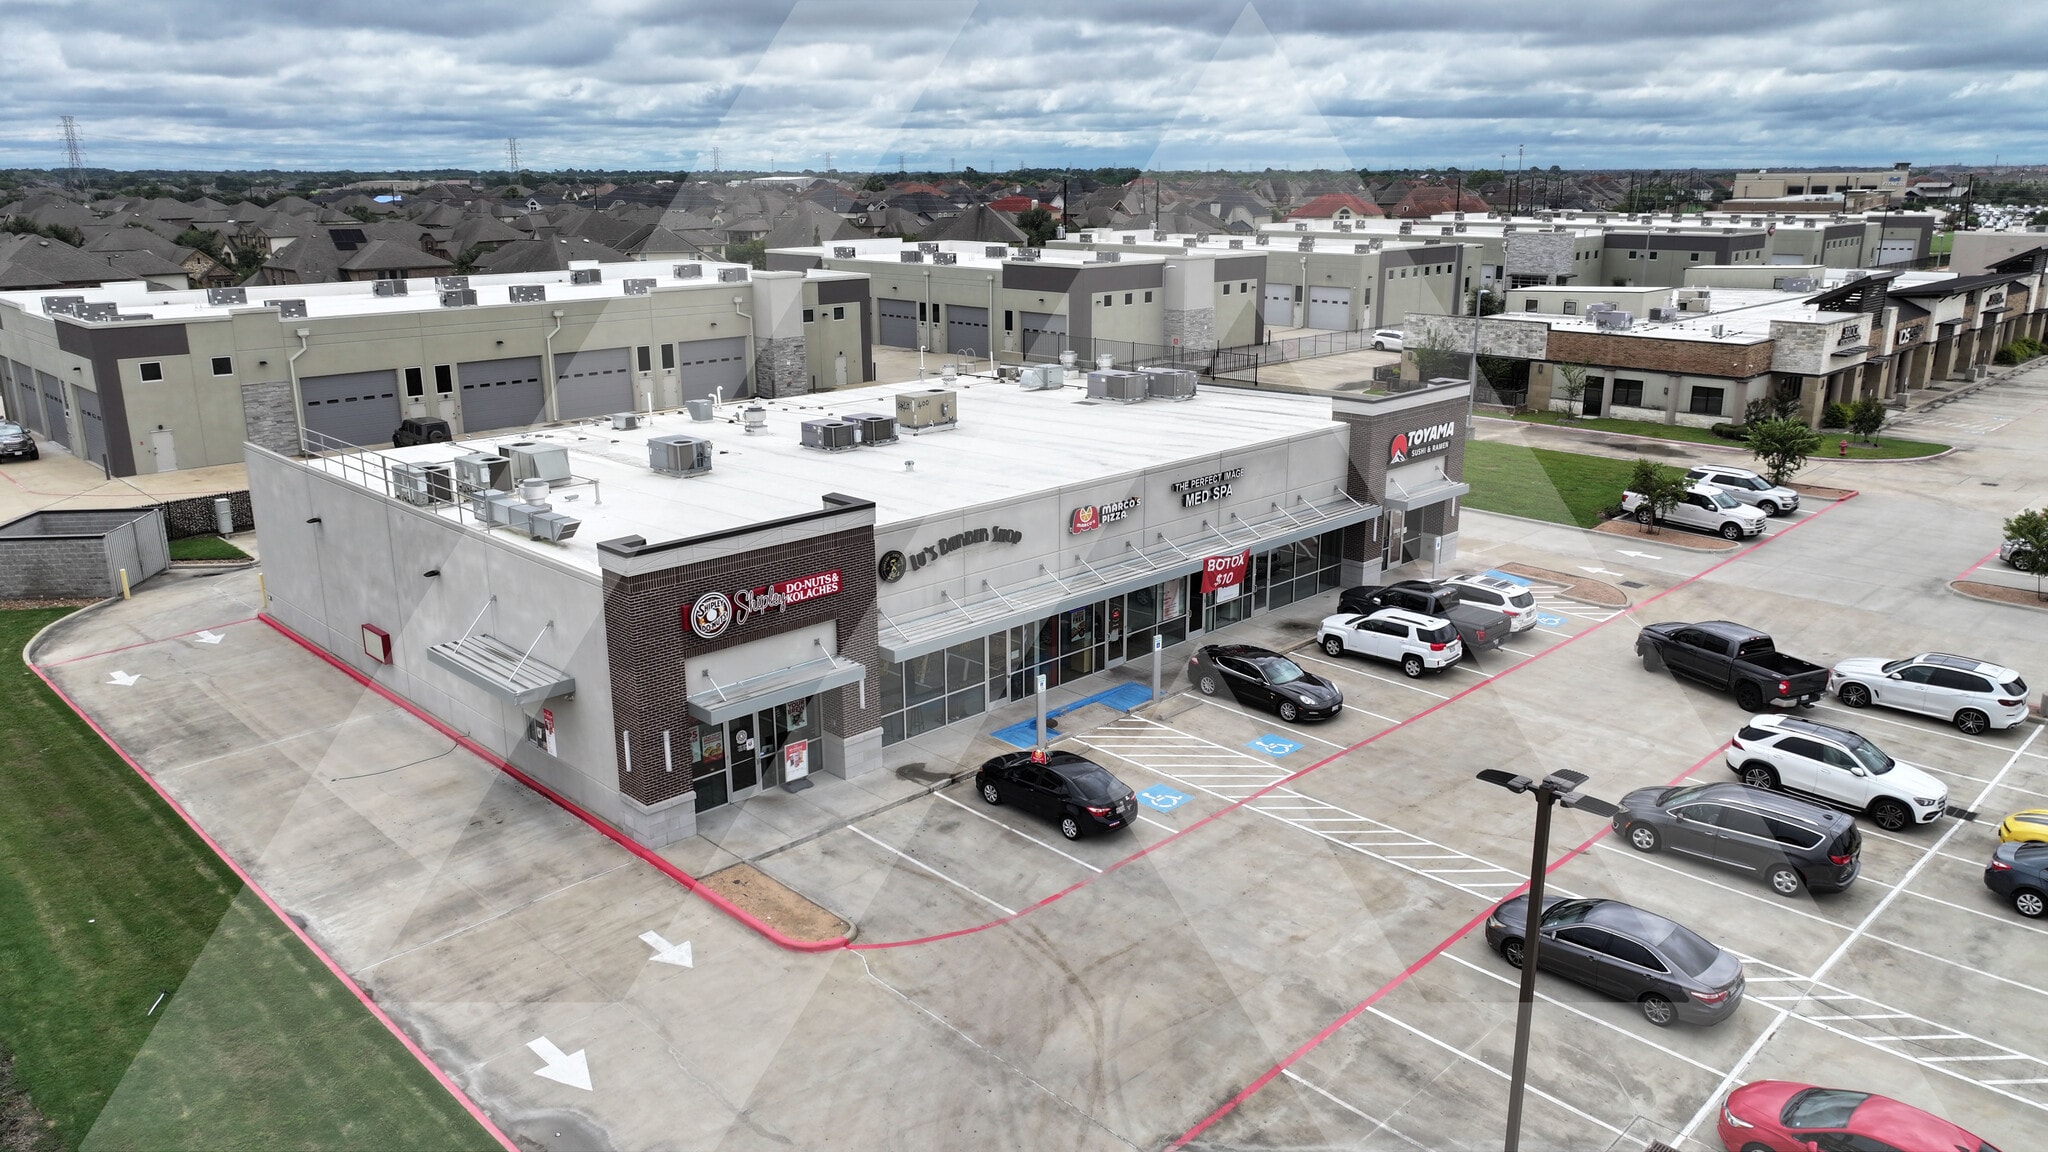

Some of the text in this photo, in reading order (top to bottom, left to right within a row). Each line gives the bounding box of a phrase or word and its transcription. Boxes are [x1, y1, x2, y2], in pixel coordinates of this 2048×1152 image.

[1408, 421, 1454, 446] TOYAMA
[1411, 447, 1426, 457] SUSHI
[1432, 441, 1450, 452] RAMEN
[1175, 467, 1245, 492] THE PERFECT IMAGE
[1185, 483, 1234, 508] MED SPA
[1101, 497, 1142, 514] MARCO'S
[1101, 511, 1127, 524] PIZZA
[1207, 554, 1245, 572] BOTOX
[1214, 572, 1235, 587] $10
[786, 583, 839, 604] KOLACHES
[697, 600, 725, 617] SHIPLEY
[733, 585, 788, 625] Shipley
